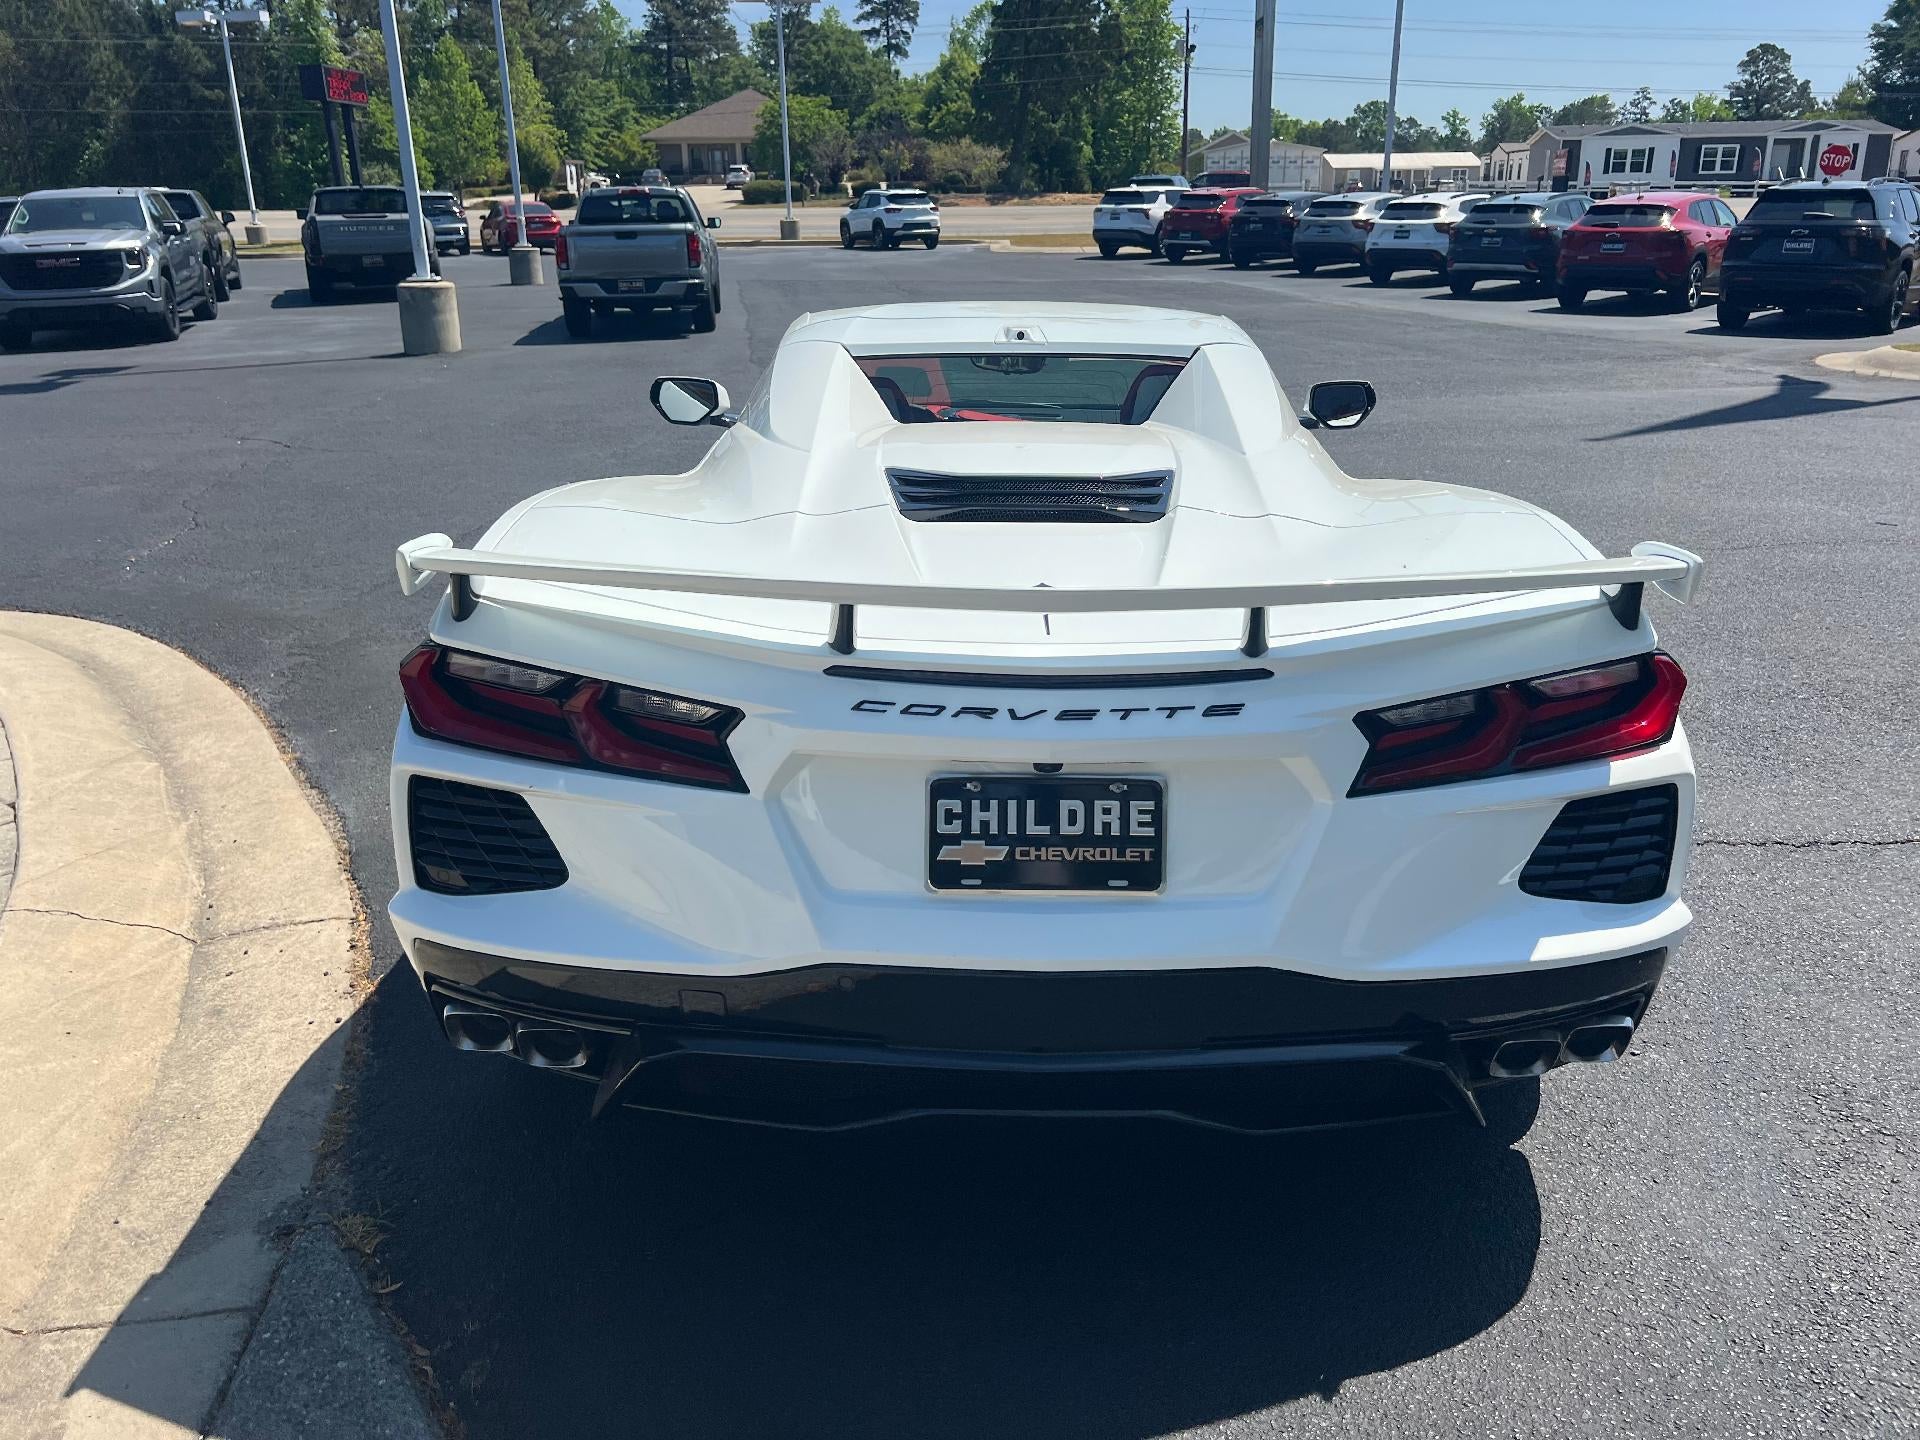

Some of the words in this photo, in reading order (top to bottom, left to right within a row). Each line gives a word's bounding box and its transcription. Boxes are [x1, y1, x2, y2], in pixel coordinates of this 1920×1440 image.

[1821, 153, 1851, 168] STOP
[851, 699, 1246, 721] CORVETTE
[936, 799, 1156, 836] CHILDRE
[1015, 846, 1156, 862] CHEVROLET
